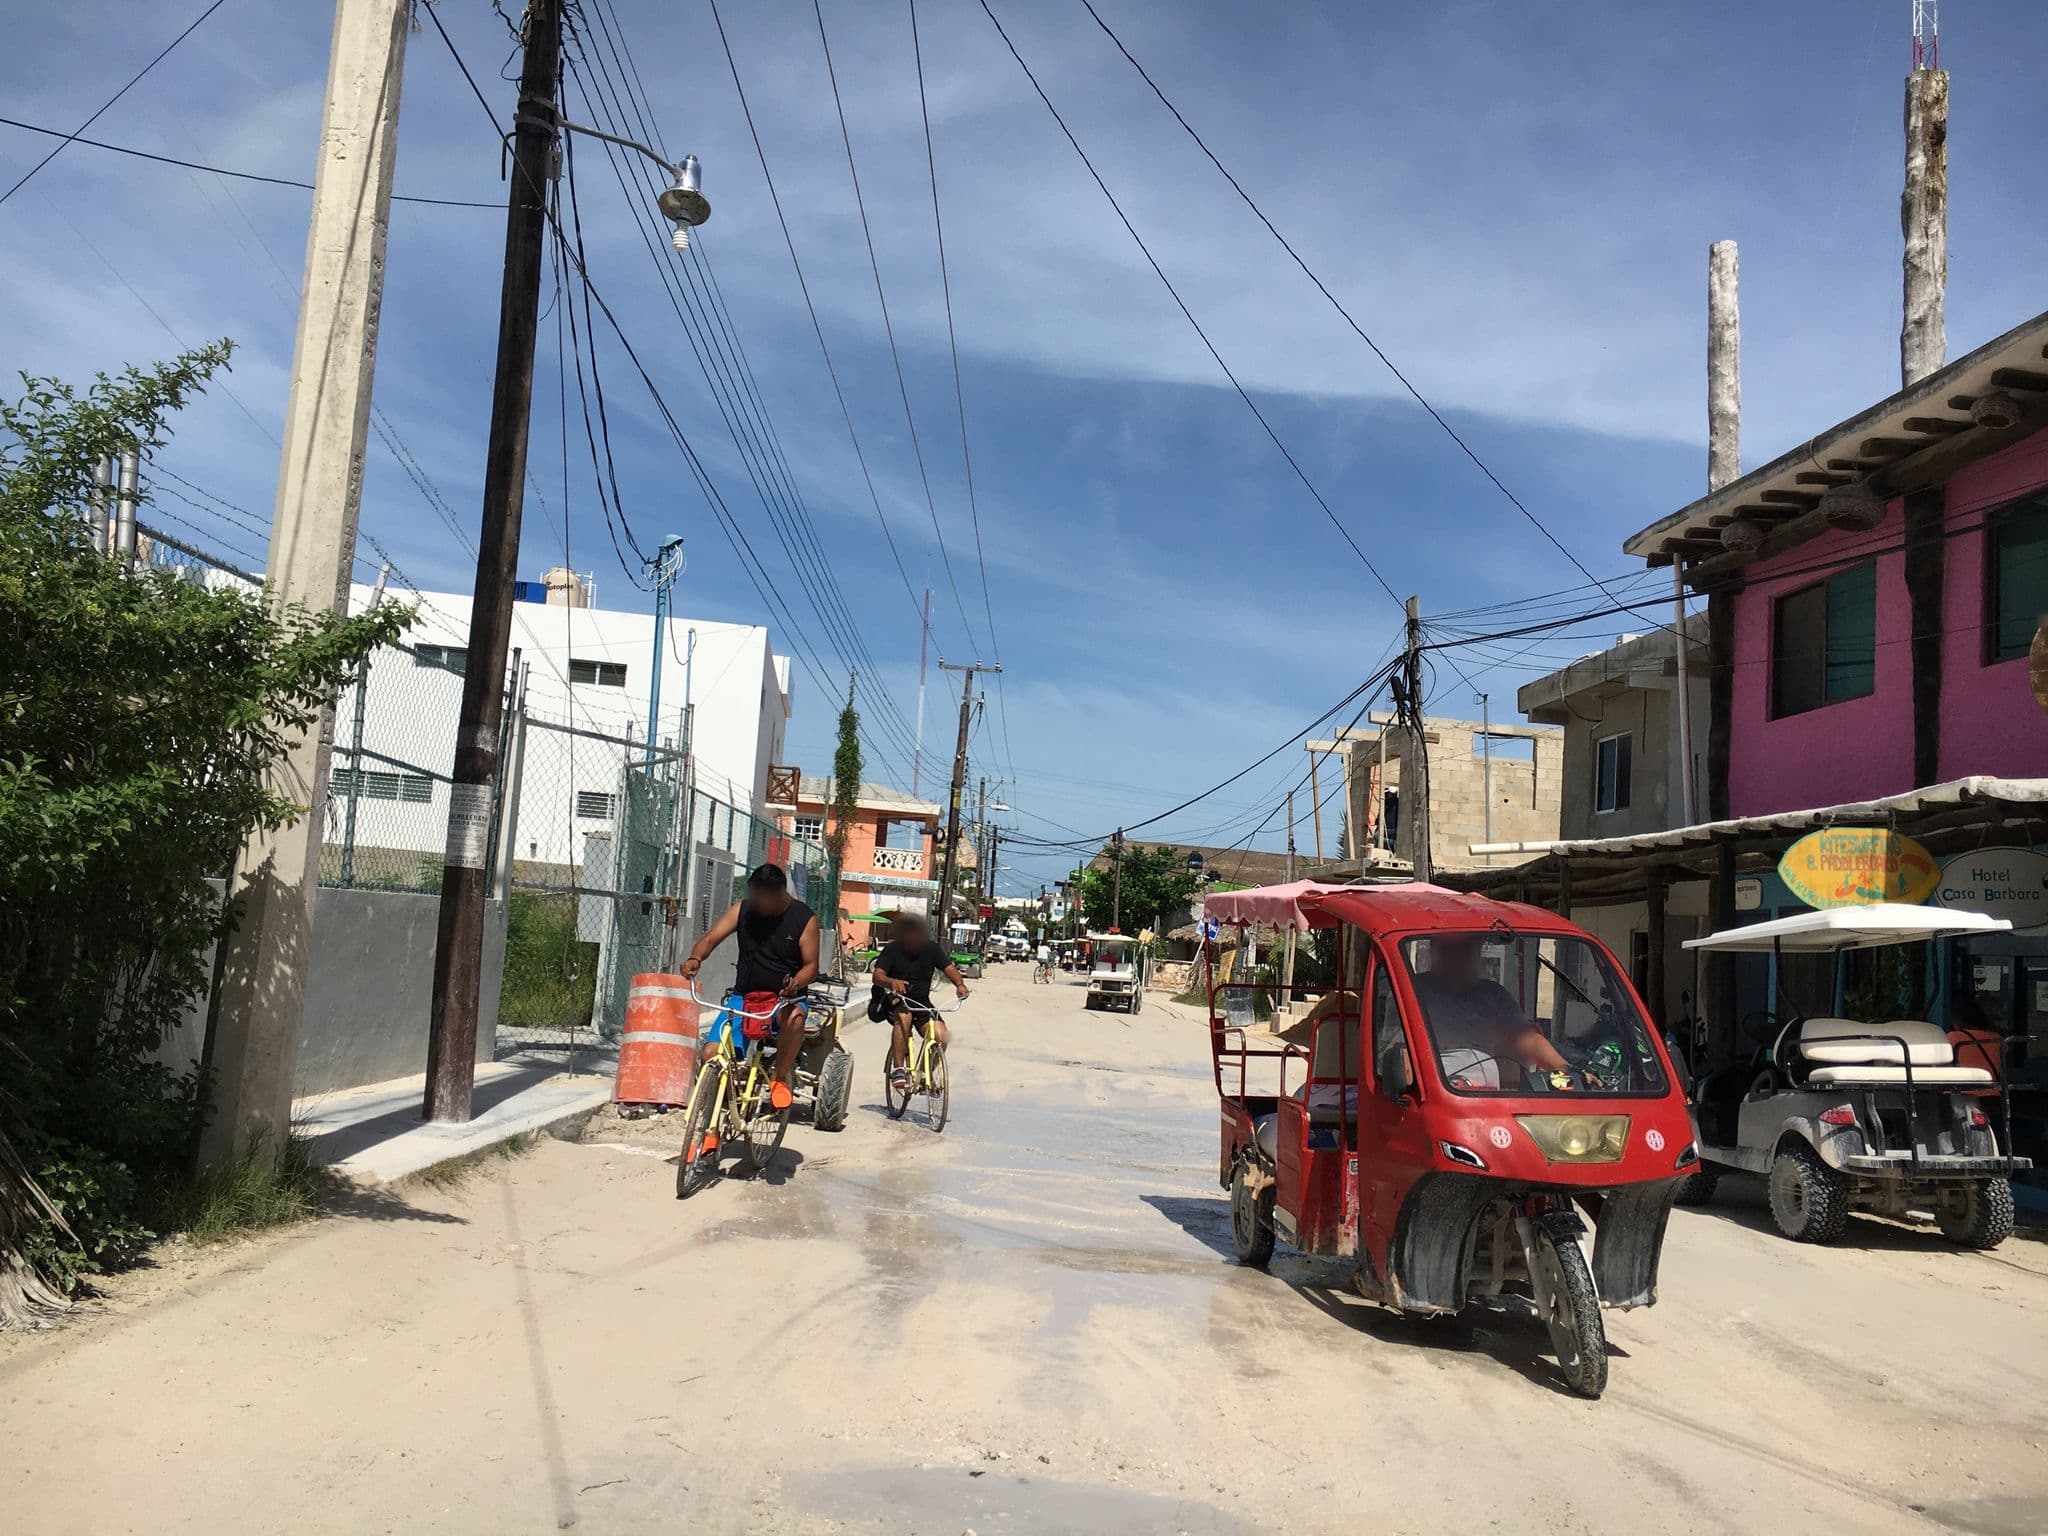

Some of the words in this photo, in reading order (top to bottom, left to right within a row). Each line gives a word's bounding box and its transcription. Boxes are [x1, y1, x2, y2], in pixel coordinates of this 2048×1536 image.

[1972, 868, 2010, 882] Hotel
[1942, 888, 1976, 902] Casa
[1984, 887, 2041, 902] Barbara
